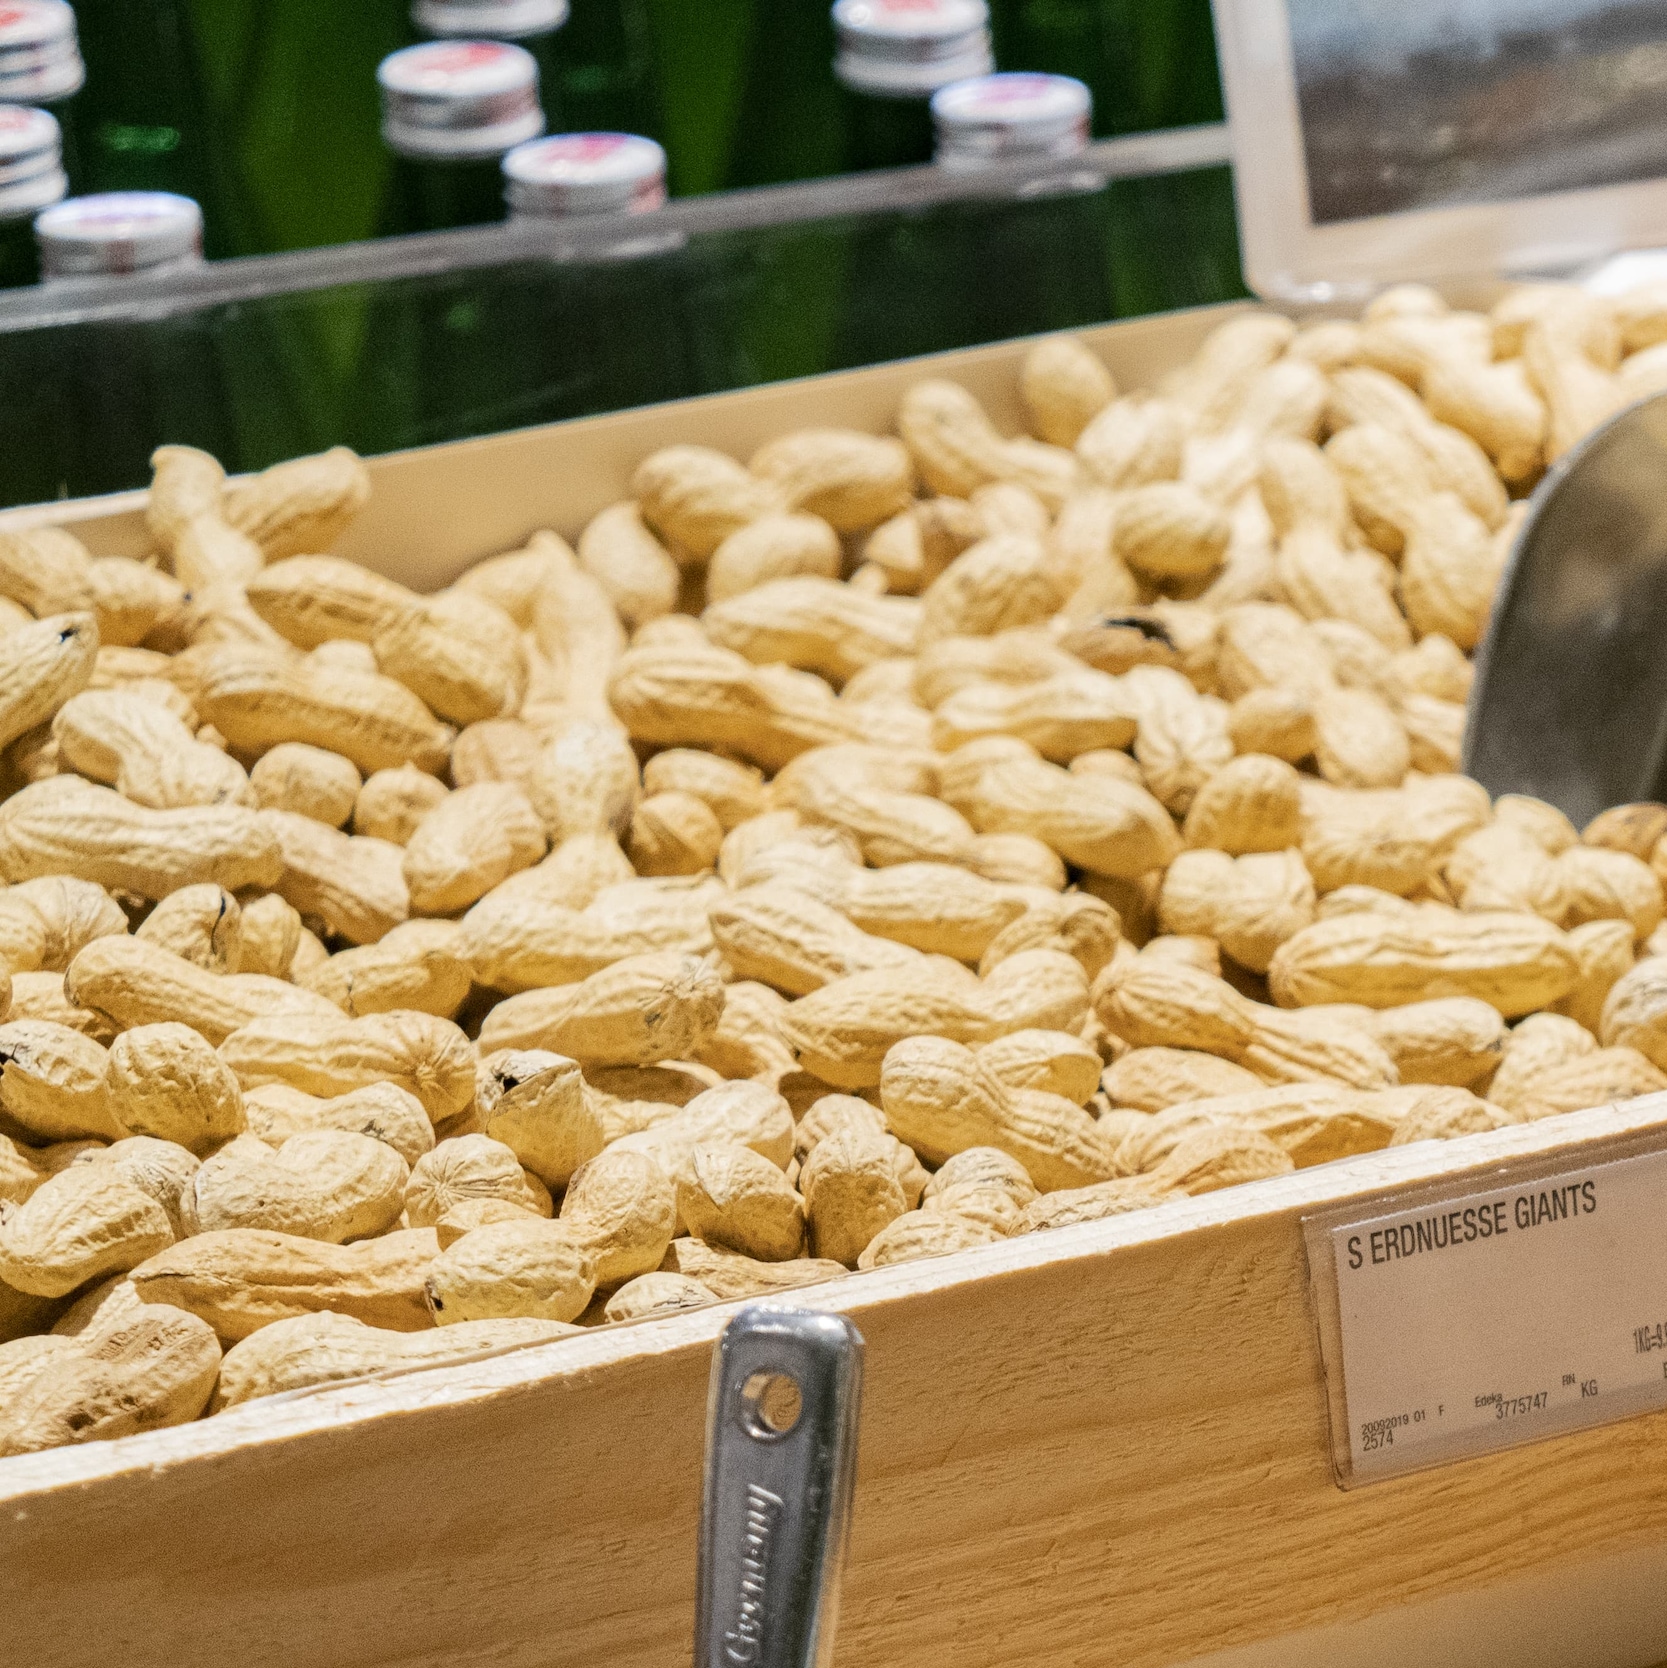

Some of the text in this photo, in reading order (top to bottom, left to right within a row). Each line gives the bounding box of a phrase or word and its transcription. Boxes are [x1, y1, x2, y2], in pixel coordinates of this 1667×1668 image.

[1348, 1180, 1597, 1269] S ERDNUESSE GIANTS
[1361, 1415, 1410, 1435] 20092019
[1438, 1405, 1445, 1417] F
[1363, 1379, 1598, 1452] 2574 3775747 KG
